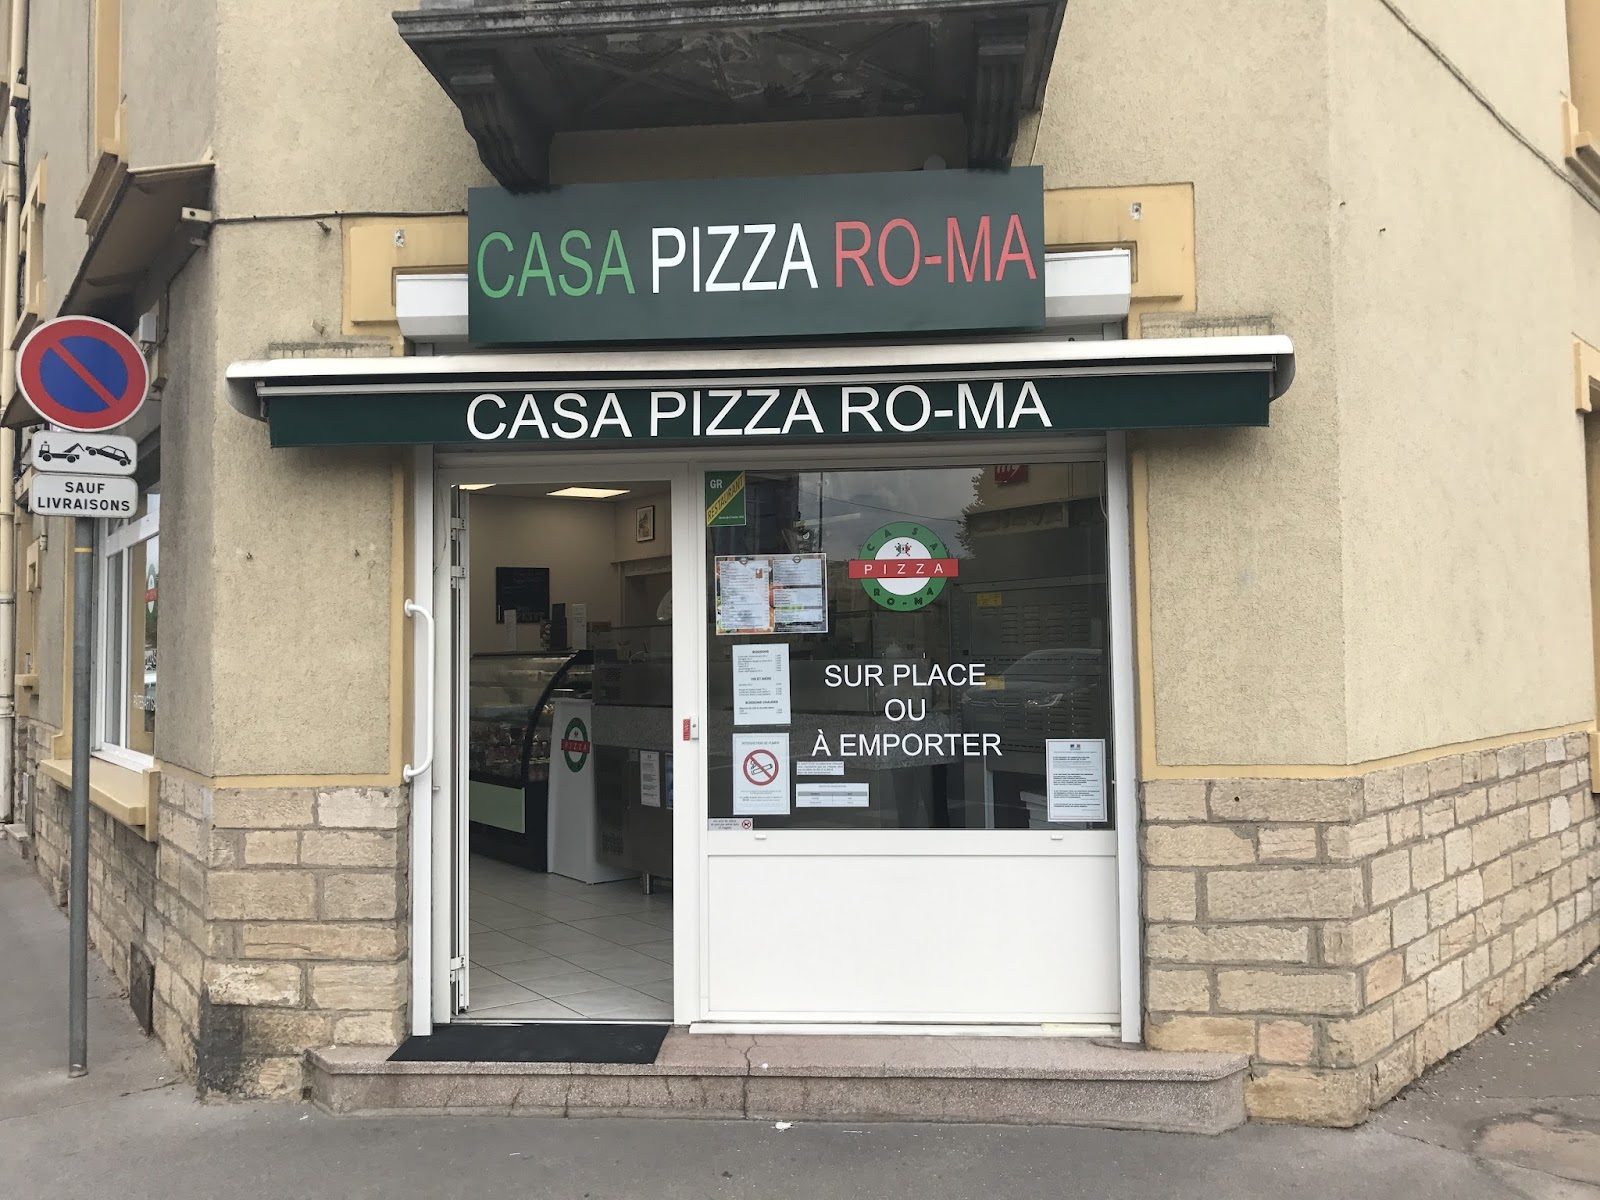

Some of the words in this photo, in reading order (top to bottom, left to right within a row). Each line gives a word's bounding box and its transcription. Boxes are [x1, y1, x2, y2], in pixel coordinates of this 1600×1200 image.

[476, 229, 635, 298] CASA
[652, 222, 819, 294] PIZZA
[835, 213, 1038, 288] RO-MA
[466, 391, 632, 440] CASA
[650, 387, 824, 437] PIZZA
[841, 380, 1053, 434] RO-MA
[65, 481, 105, 494] SAUF
[710, 479, 723, 488] GR
[37, 496, 130, 512] LIVRAISONS
[707, 476, 744, 520] RESTAURANT
[867, 528, 938, 551] CASA
[864, 563, 943, 574] PIZZA
[824, 664, 885, 687] SUR
[893, 663, 987, 687] PLACE
[884, 698, 926, 722] OU
[811, 729, 832, 757] À
[839, 733, 1003, 757] EMPORTER
